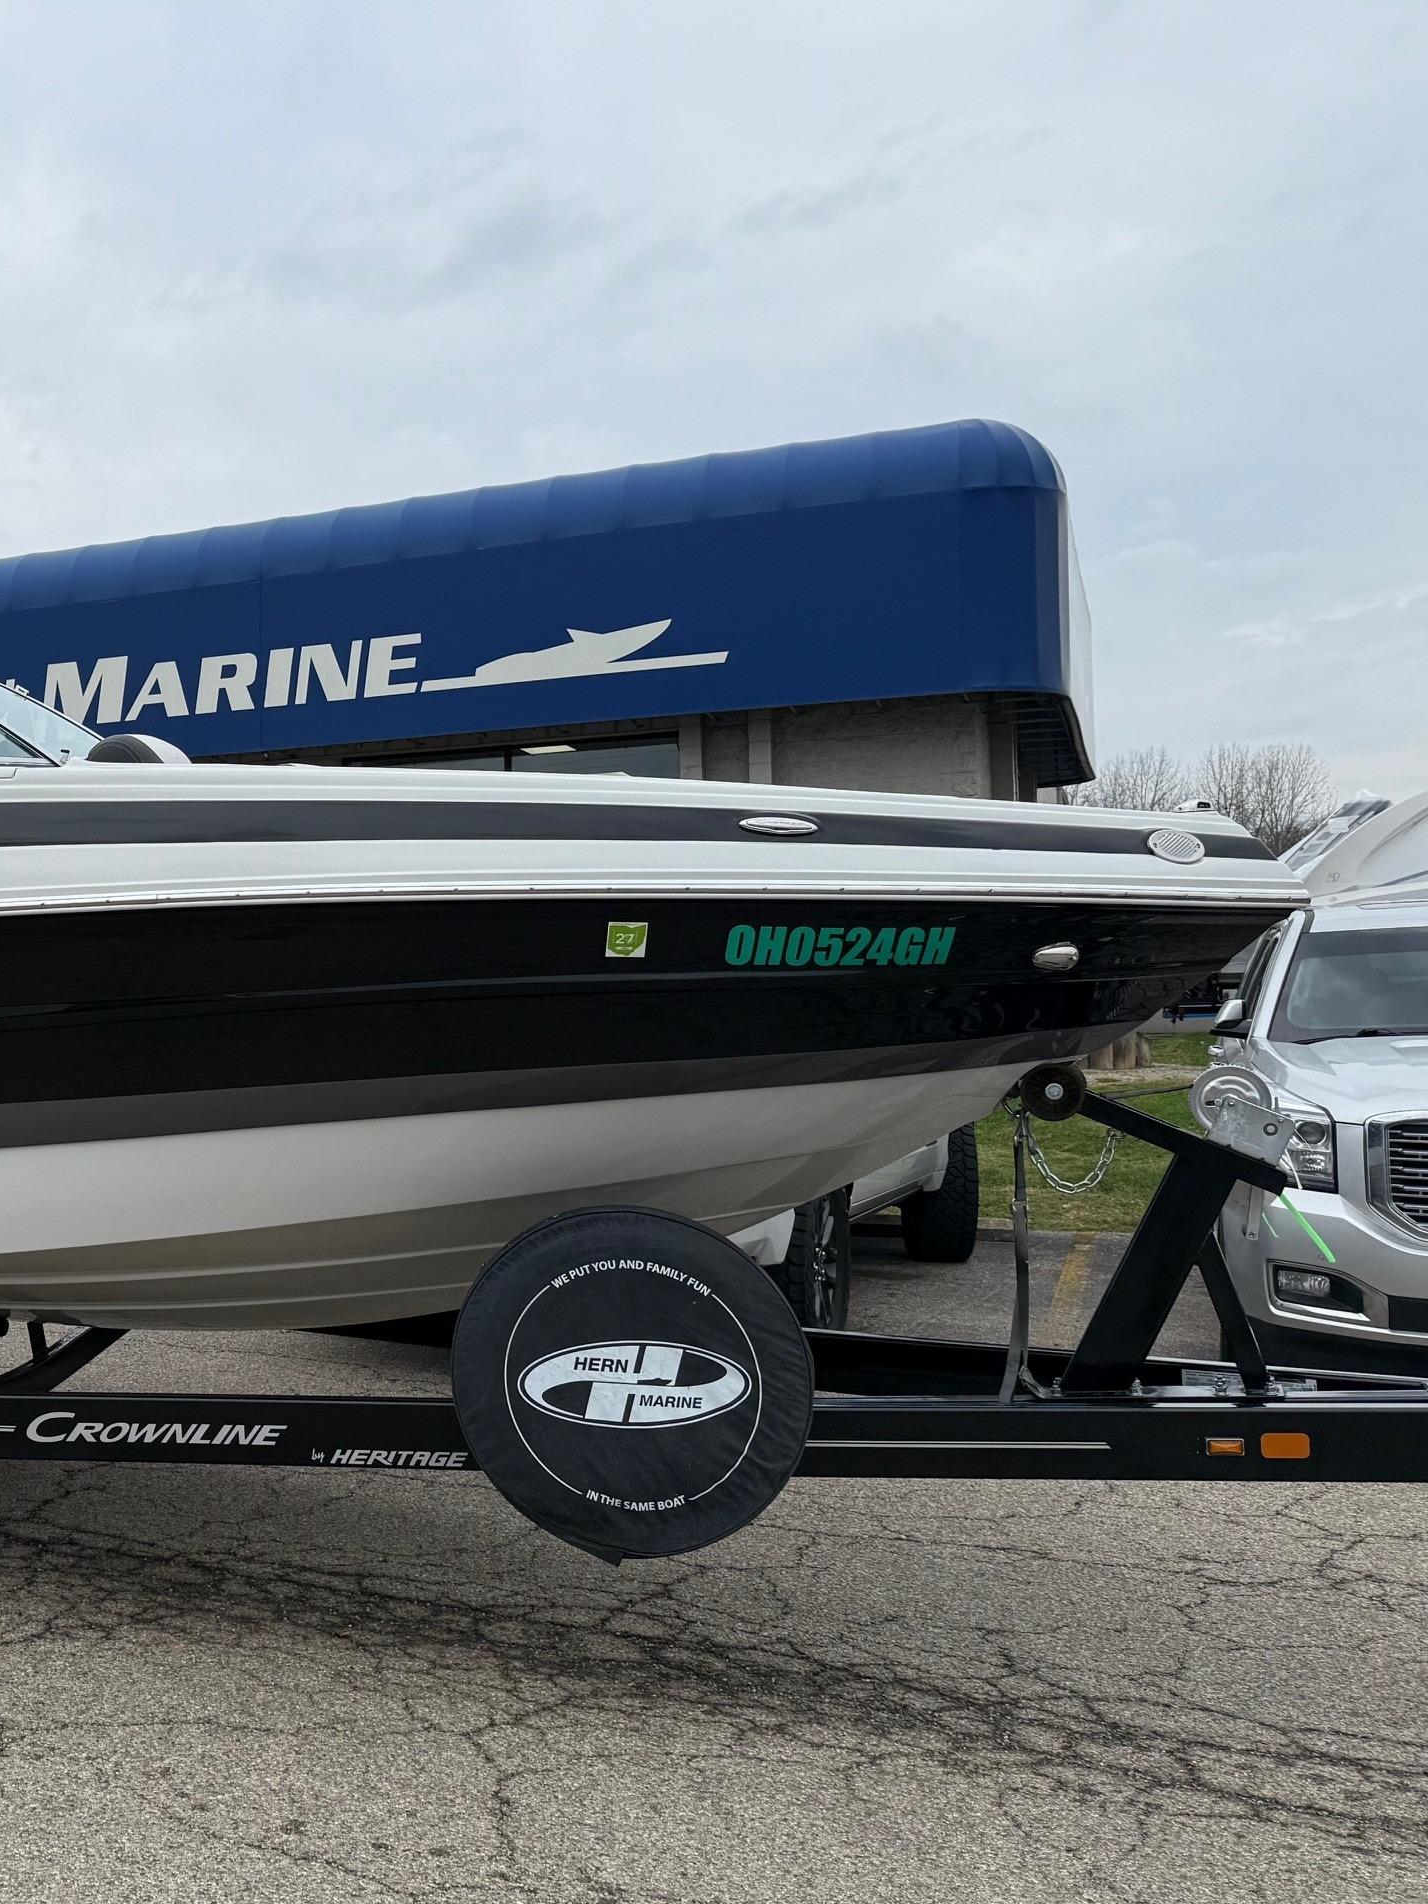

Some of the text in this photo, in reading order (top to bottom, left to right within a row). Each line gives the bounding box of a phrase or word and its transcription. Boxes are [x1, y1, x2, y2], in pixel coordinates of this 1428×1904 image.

[43, 632, 422, 725] MARINE
[615, 933, 634, 944] 27
[724, 924, 957, 967] OH0524GH
[551, 1259, 712, 1297] WE PUT YOU AND FAMILY FUN
[573, 1357, 629, 1373] HERN
[639, 1394, 703, 1409] MARINE
[26, 1411, 288, 1446] CROWNLINE
[311, 1448, 468, 1467] by HERITAGE
[586, 1489, 686, 1512] IN THE SAME BOAT
